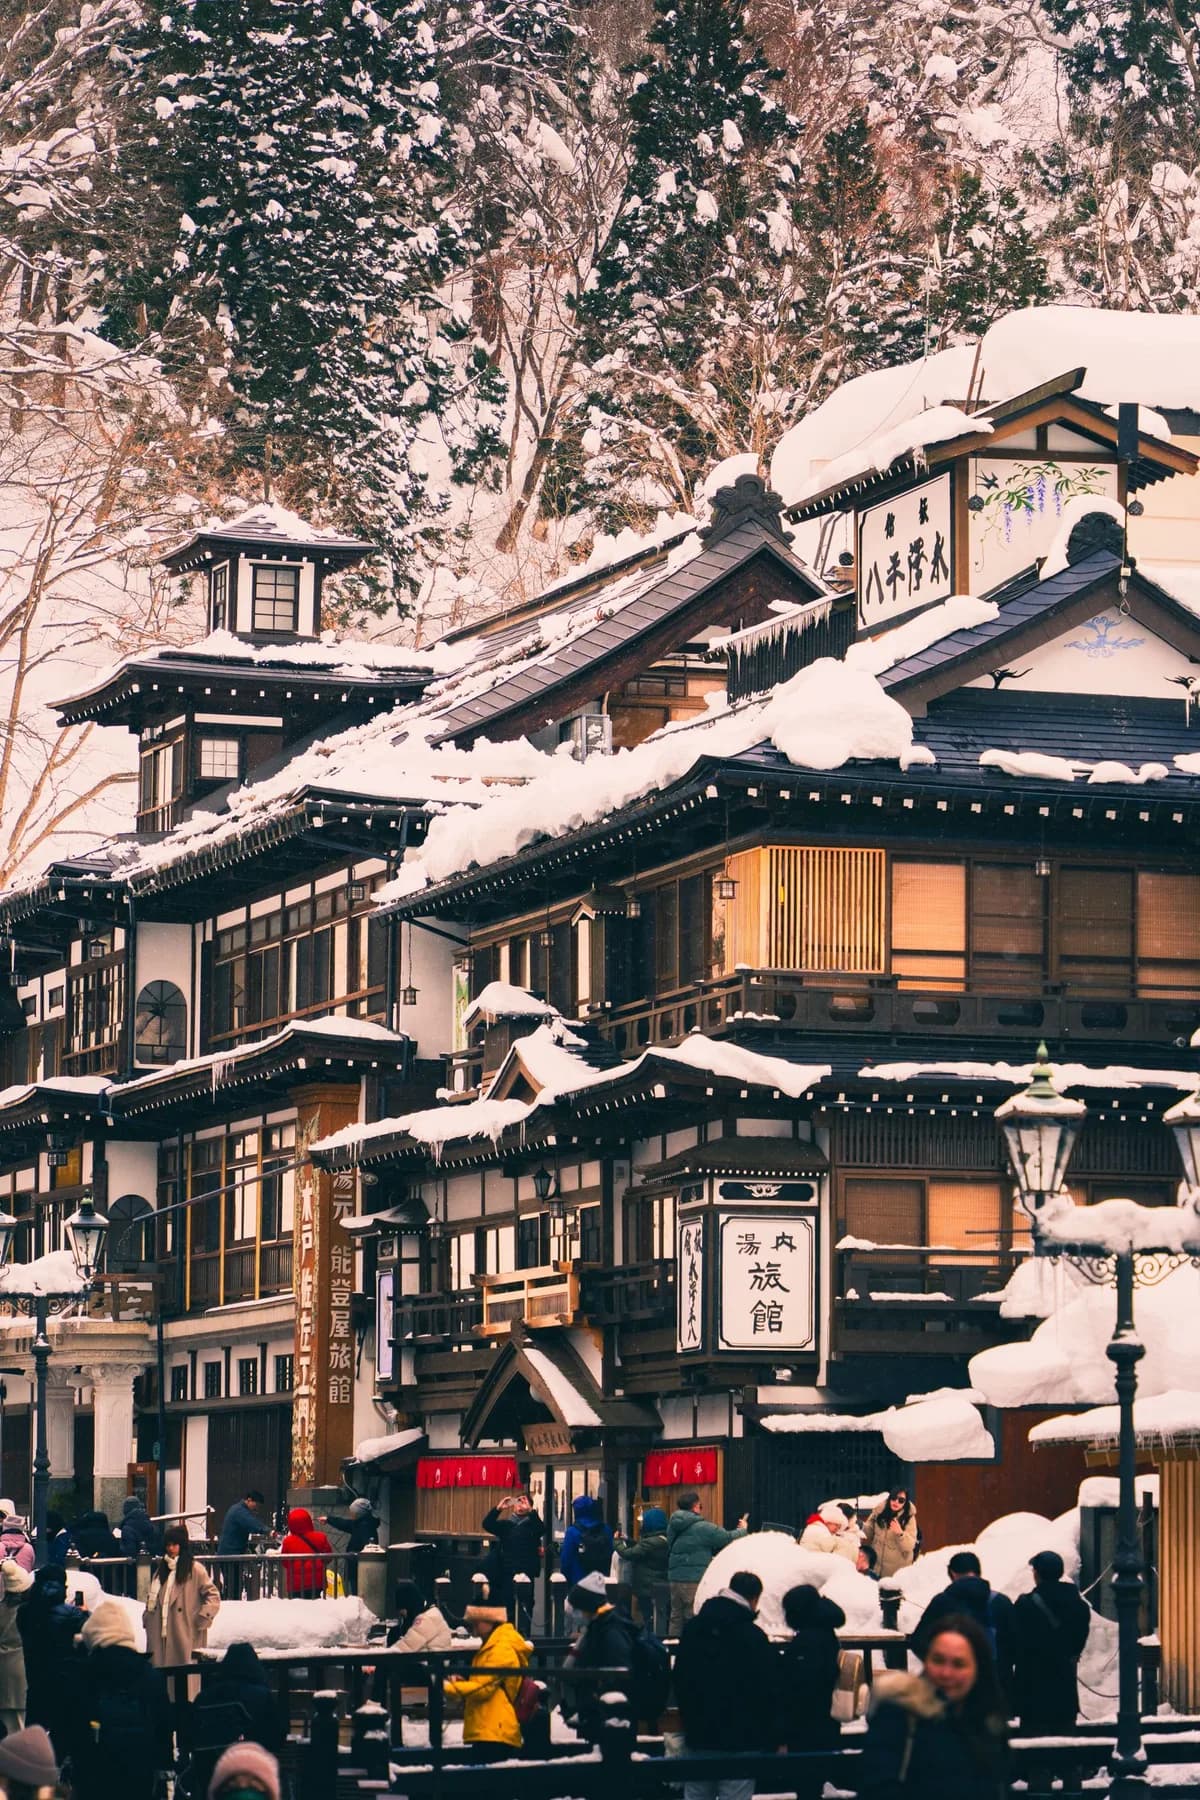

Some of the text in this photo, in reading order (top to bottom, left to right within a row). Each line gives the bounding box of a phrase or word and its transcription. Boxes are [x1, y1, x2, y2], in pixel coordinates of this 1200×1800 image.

[329, 1244, 352, 1404] 能登屋旅館
[748, 1261, 790, 1335] 旅館
